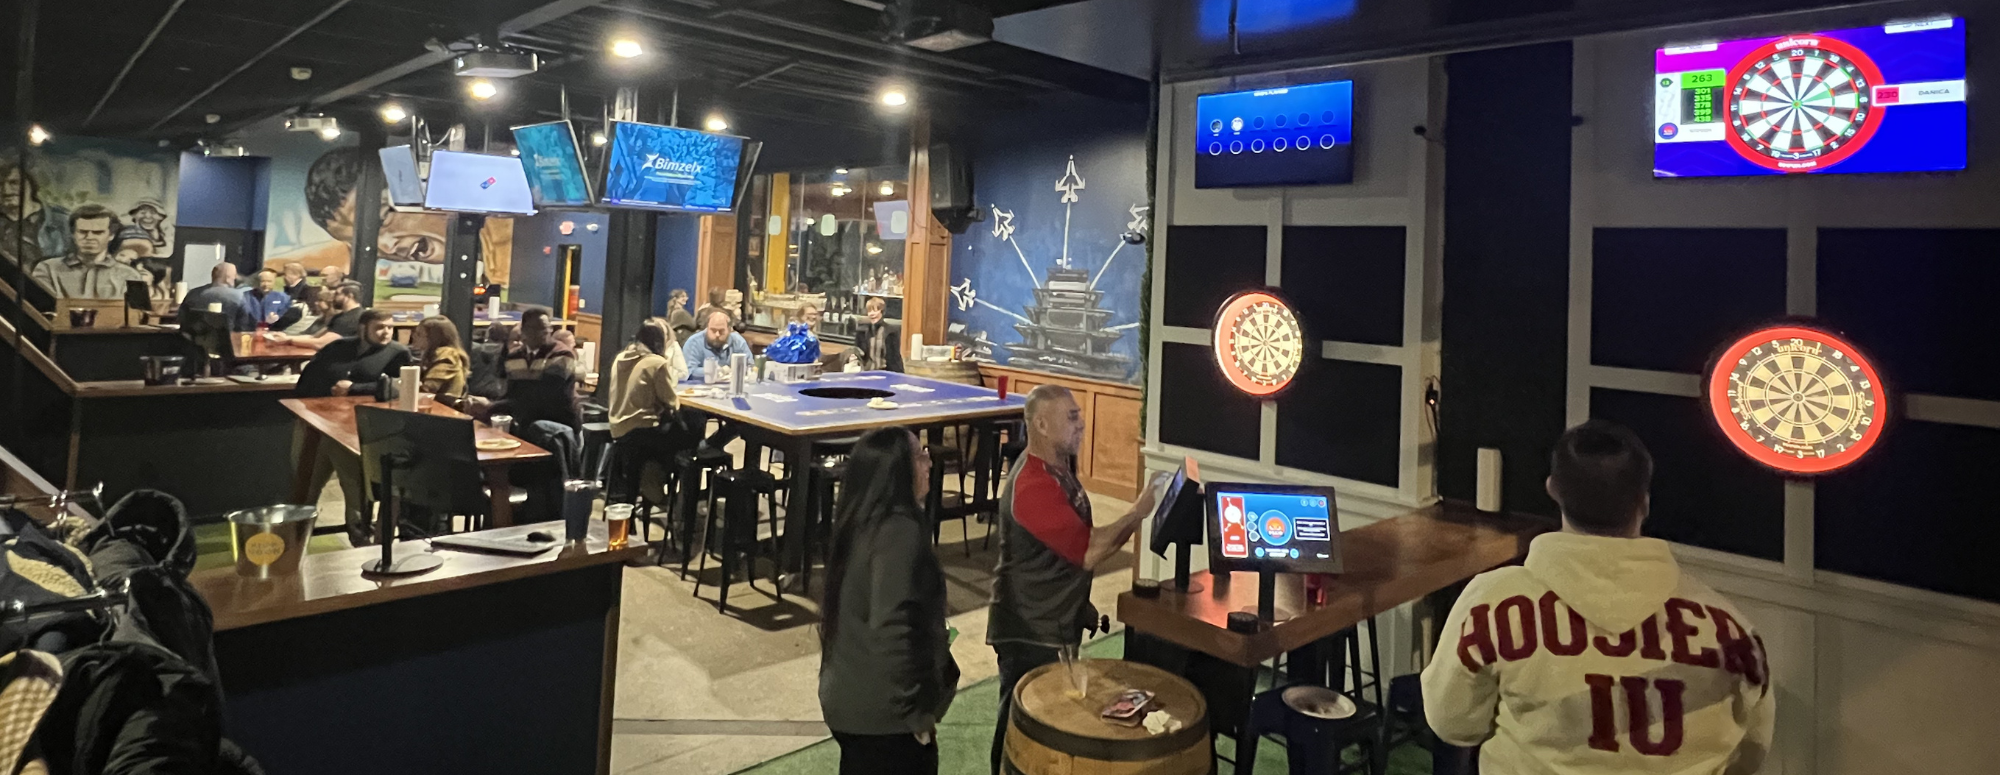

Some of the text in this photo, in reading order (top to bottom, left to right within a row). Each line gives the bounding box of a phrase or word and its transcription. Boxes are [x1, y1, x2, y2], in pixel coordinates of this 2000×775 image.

[1775, 38, 1820, 50] unicorn
[1772, 54, 1780, 62] 5
[1692, 74, 1712, 82] 263
[1856, 112, 1866, 122] 10
[1844, 128, 1856, 137] 15
[1811, 148, 1822, 157] 17
[654, 157, 702, 173] Bimzelx
[1772, 340, 1780, 348] 5
[1790, 338, 1804, 347] 20
[1740, 421, 1750, 430] 16
[1860, 416, 1872, 426] 10
[1836, 444, 1846, 452] 2
[1796, 450, 1804, 458] 3
[1457, 590, 1770, 700] HOOSIER
[1585, 673, 1685, 756] IU
